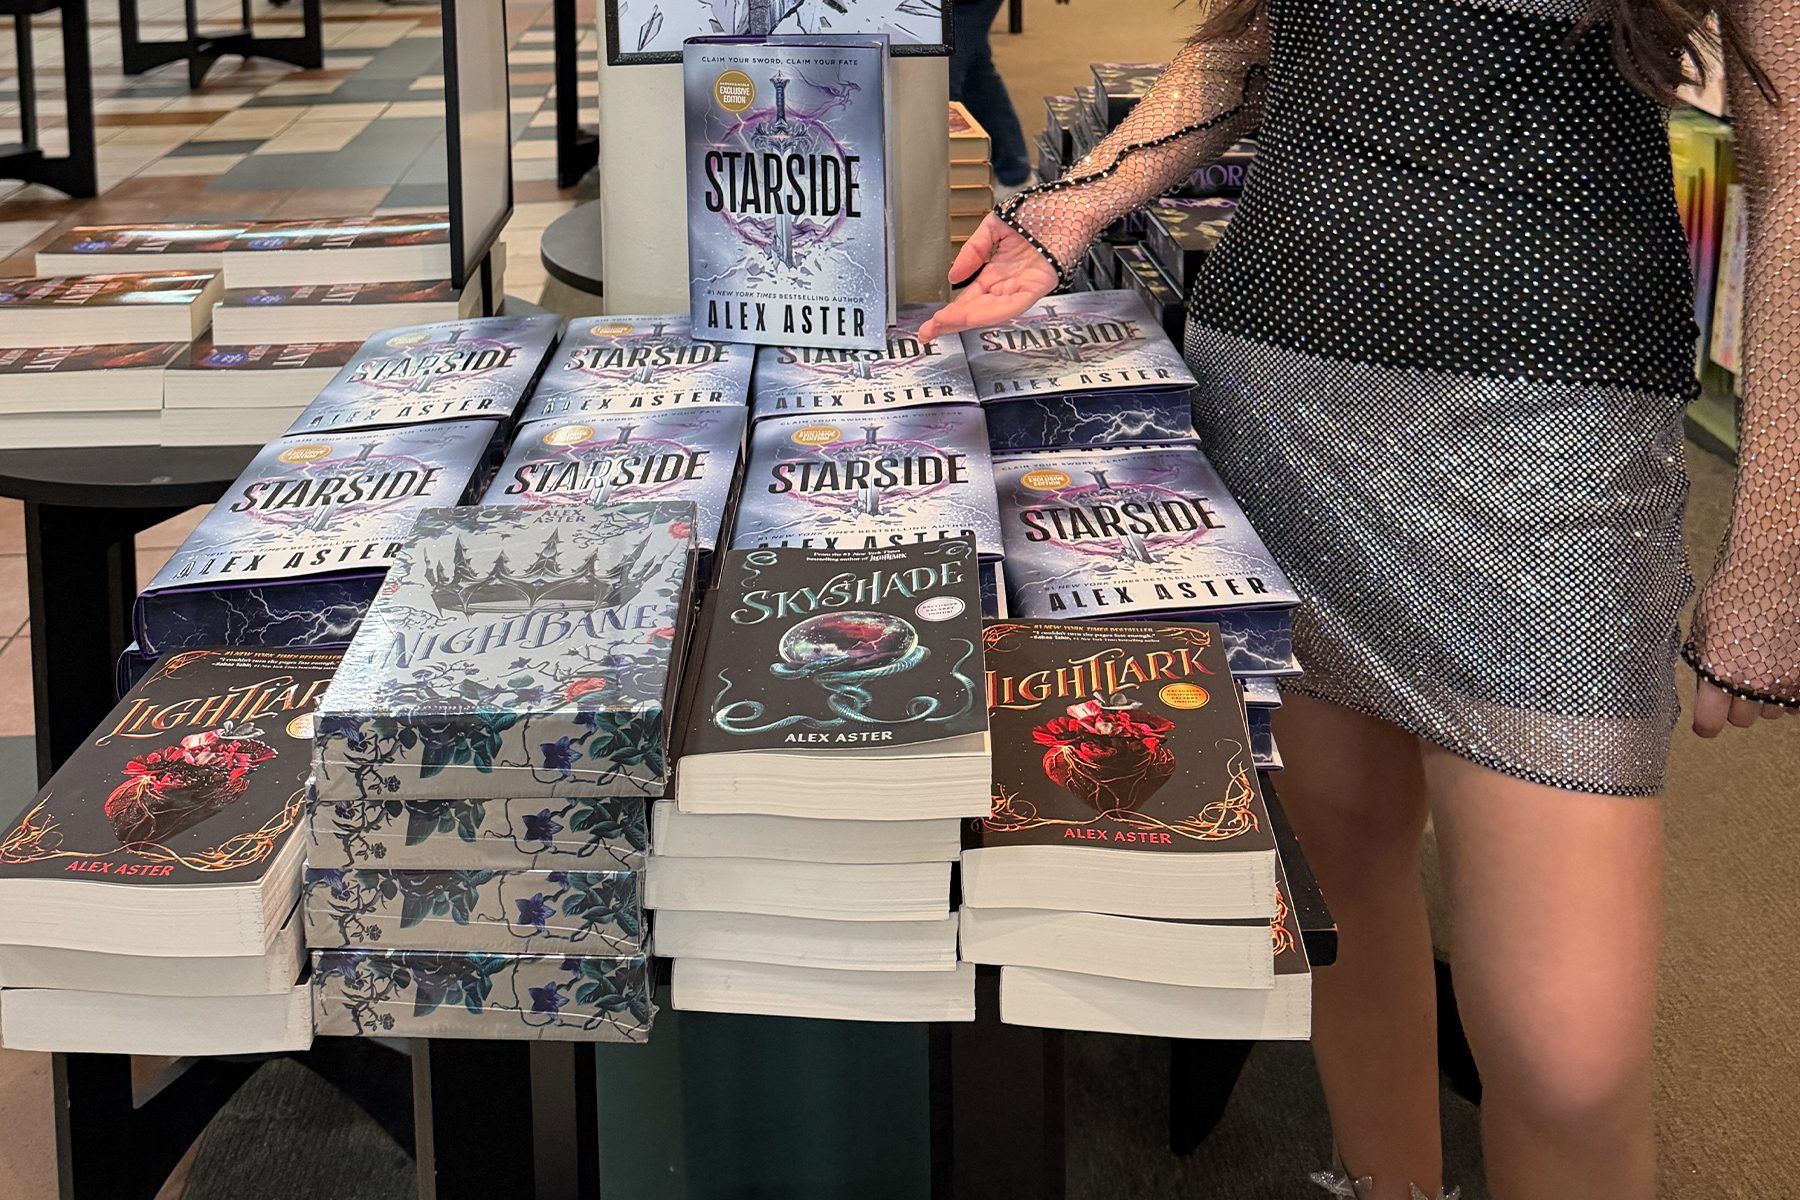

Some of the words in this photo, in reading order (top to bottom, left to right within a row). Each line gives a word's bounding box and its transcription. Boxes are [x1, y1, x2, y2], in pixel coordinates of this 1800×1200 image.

[752, 57, 783, 65] SWORD,
[719, 86, 750, 96] EXCLUSIVE
[723, 95, 746, 104] EDITION
[705, 150, 861, 218] STARSIDE
[778, 293, 829, 302] BESTSELLING
[832, 296, 865, 304] AUTHOR
[708, 300, 766, 331] ALEX
[783, 304, 865, 337] ASTER
[979, 319, 1147, 352] STARSIDE
[345, 346, 523, 384] STARSIDE
[563, 341, 733, 371] STARSIDE
[994, 377, 1062, 394] ALEX
[1080, 367, 1172, 384] ASTER
[541, 398, 613, 415] ALEX
[629, 391, 723, 408] ASTER
[775, 394, 844, 410] ALEX
[863, 385, 954, 405] ASTER
[307, 408, 382, 428] ALEX
[395, 398, 494, 418] ASTER
[504, 450, 710, 495] STARSIDE
[768, 453, 969, 494] STARSIDE
[229, 466, 447, 513] STARSIDE
[532, 515, 586, 524] ASTER
[542, 508, 581, 517] ALEX
[1019, 497, 1226, 542] STARSIDE
[173, 555, 267, 579] ALEX
[283, 542, 404, 570] ASTER
[1143, 572, 1210, 582] BESTSELLING
[731, 561, 965, 625] SKYSHADE
[1050, 586, 1134, 612] ALEX
[1155, 576, 1269, 601] ASTER
[394, 602, 658, 669] NIGHTBANE
[985, 647, 1217, 710] LIGHTLARK
[95, 675, 332, 747] LIGHTLAR
[785, 732, 831, 744] ALEX
[835, 730, 893, 743] ASTER
[1063, 827, 1108, 841] ALEX
[1114, 831, 1172, 844] ASTER
[65, 859, 113, 875] ALEX
[114, 861, 174, 877] ASTER
